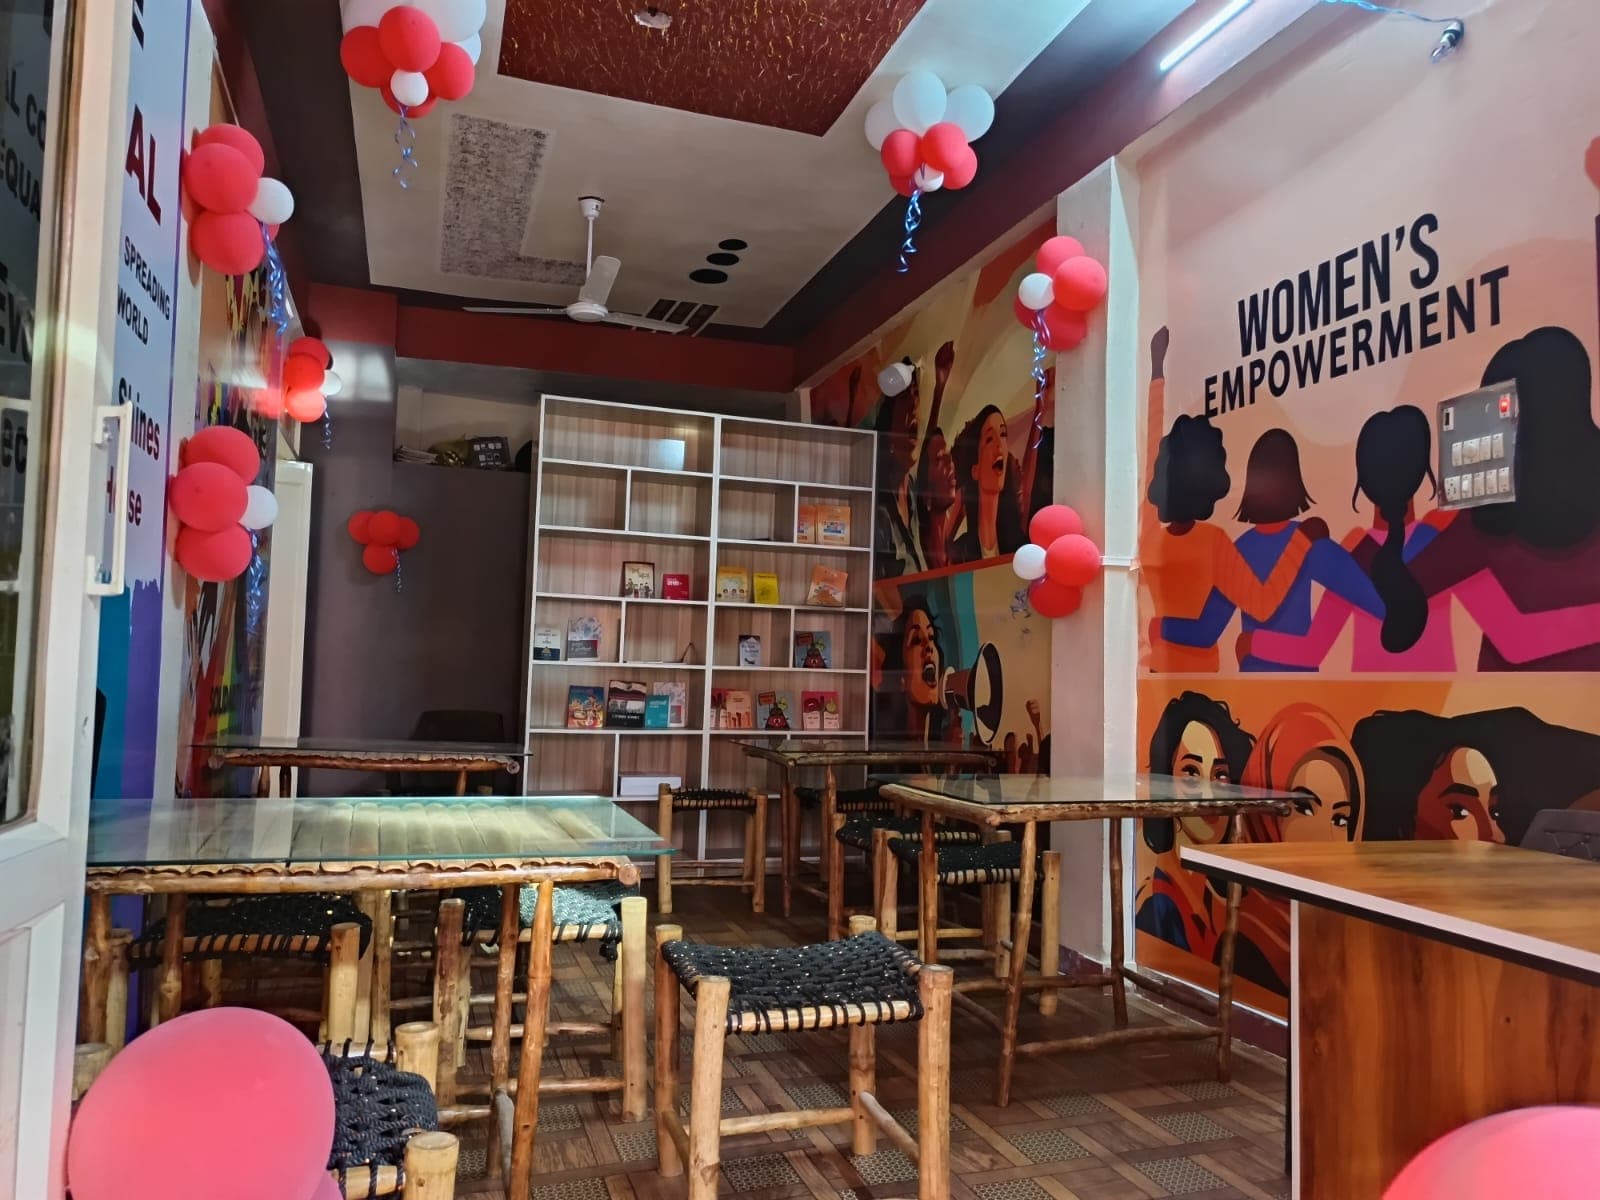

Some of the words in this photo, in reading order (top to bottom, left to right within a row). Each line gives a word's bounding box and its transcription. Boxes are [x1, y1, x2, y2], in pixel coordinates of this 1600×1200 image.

[117, 283, 149, 345] WORLD
[124, 235, 170, 320] SPREADING
[1238, 213, 1439, 357] WOMEN'S
[1205, 265, 1509, 418] EMPOWERMENT
